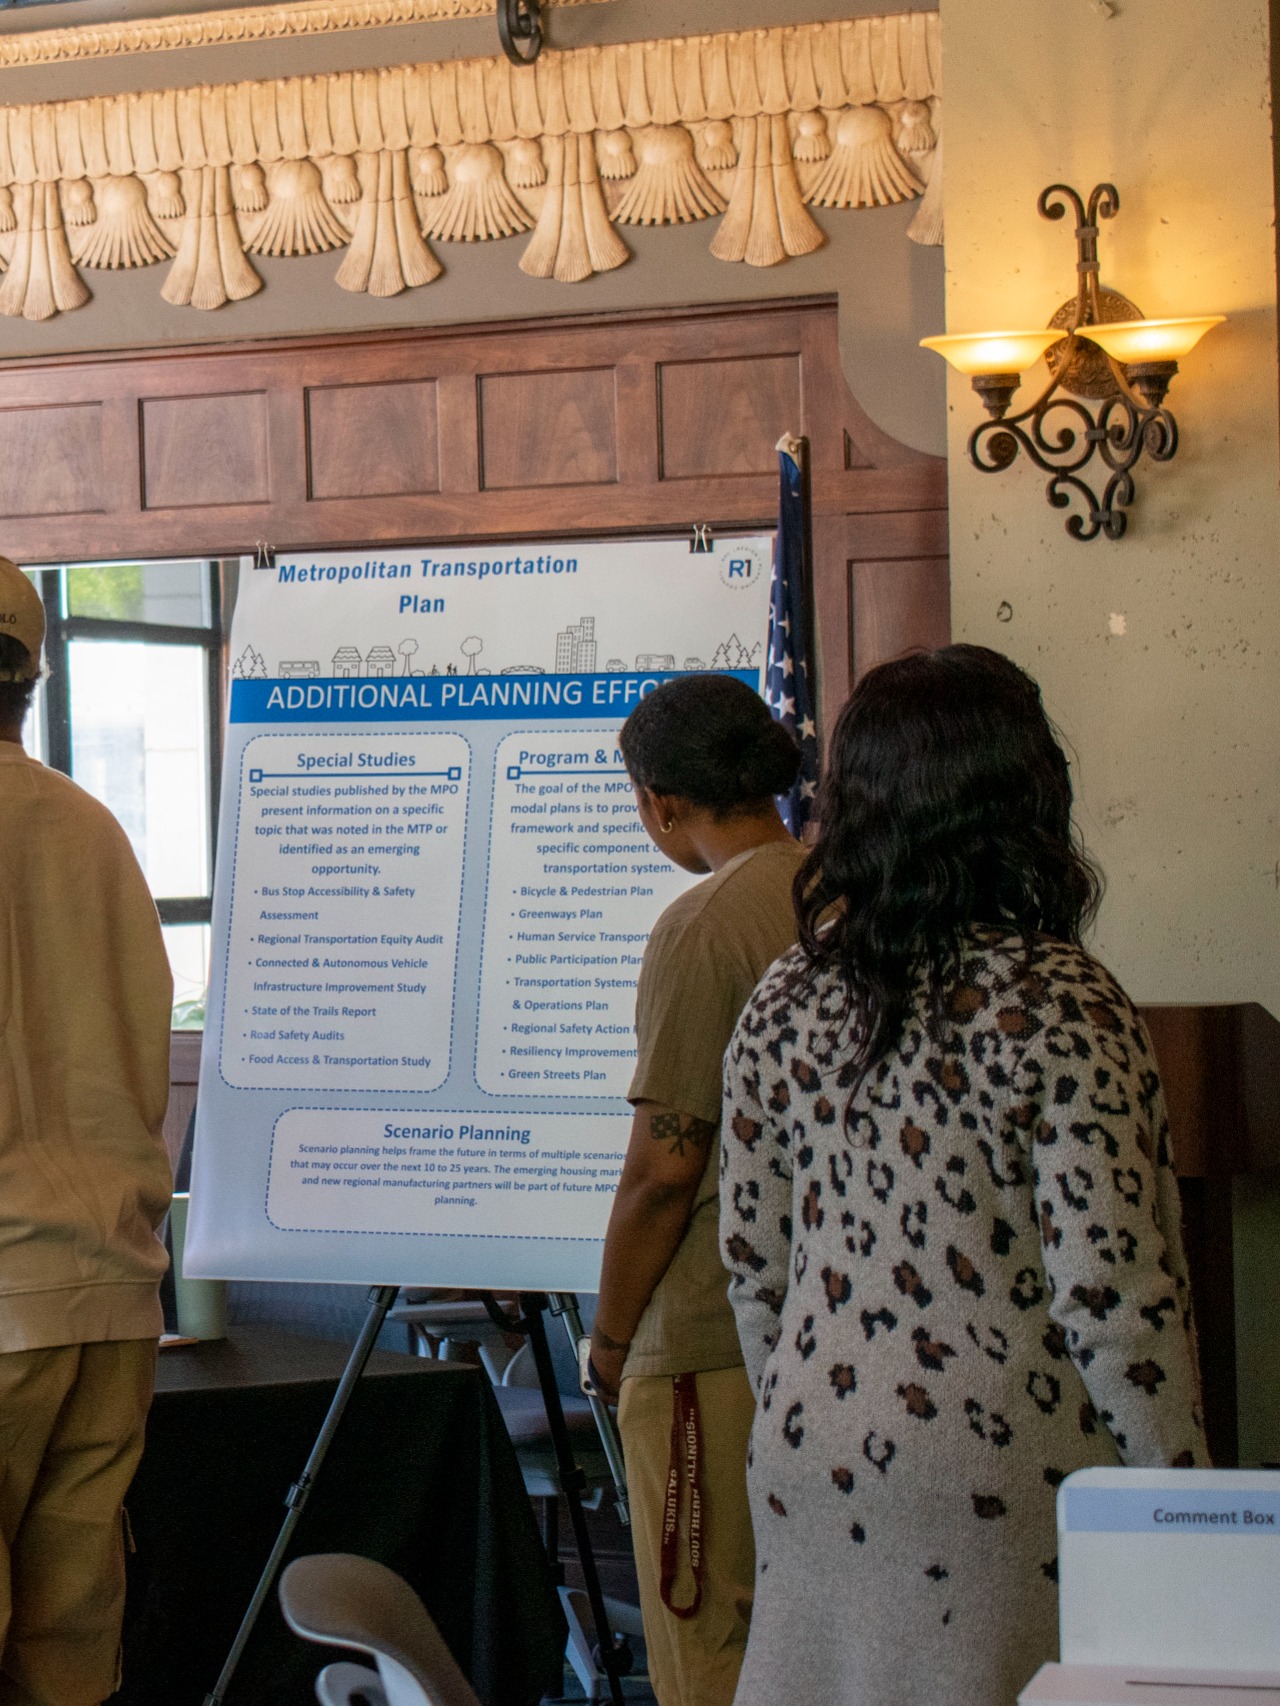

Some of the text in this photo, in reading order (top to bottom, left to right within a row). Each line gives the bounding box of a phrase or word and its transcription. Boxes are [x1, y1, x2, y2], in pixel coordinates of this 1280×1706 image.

[278, 555, 577, 583] Metropolitan Transportation
[728, 559, 752, 578] R1
[399, 594, 444, 613] Plan
[266, 684, 432, 709] ADDITIONAL
[441, 680, 582, 706] PLANNING
[297, 752, 415, 770] Special Studies
[519, 749, 607, 768] Program &
[250, 784, 458, 798] Special studies published by the MPO
[278, 843, 420, 856] identified as an emerging
[311, 863, 381, 876] opportunity.
[543, 862, 674, 875] transportation system.
[261, 886, 415, 898] Bus Stop Accessibility & Safety
[520, 886, 653, 898] Bicycle & Pedestrian Plan
[259, 910, 319, 920] Assessment
[518, 908, 602, 920] Greenways Plan
[250, 1029, 344, 1042] Road Safety Audits
[508, 1068, 606, 1080] Green Streets Plan
[383, 1123, 530, 1144] Scenario Planning
[298, 1143, 338, 1153] Scenario
[339, 1145, 380, 1156] planning
[382, 1146, 407, 1156] helps
[409, 1146, 436, 1156] frame
[438, 1147, 454, 1156] the
[456, 1147, 486, 1157] future
[488, 1149, 497, 1157] in
[499, 1149, 526, 1158] terms
[528, 1149, 539, 1158] of
[541, 1150, 581, 1160] multiple
[434, 1195, 477, 1207] planning.
[1153, 1509, 1274, 1524] Comment Box
